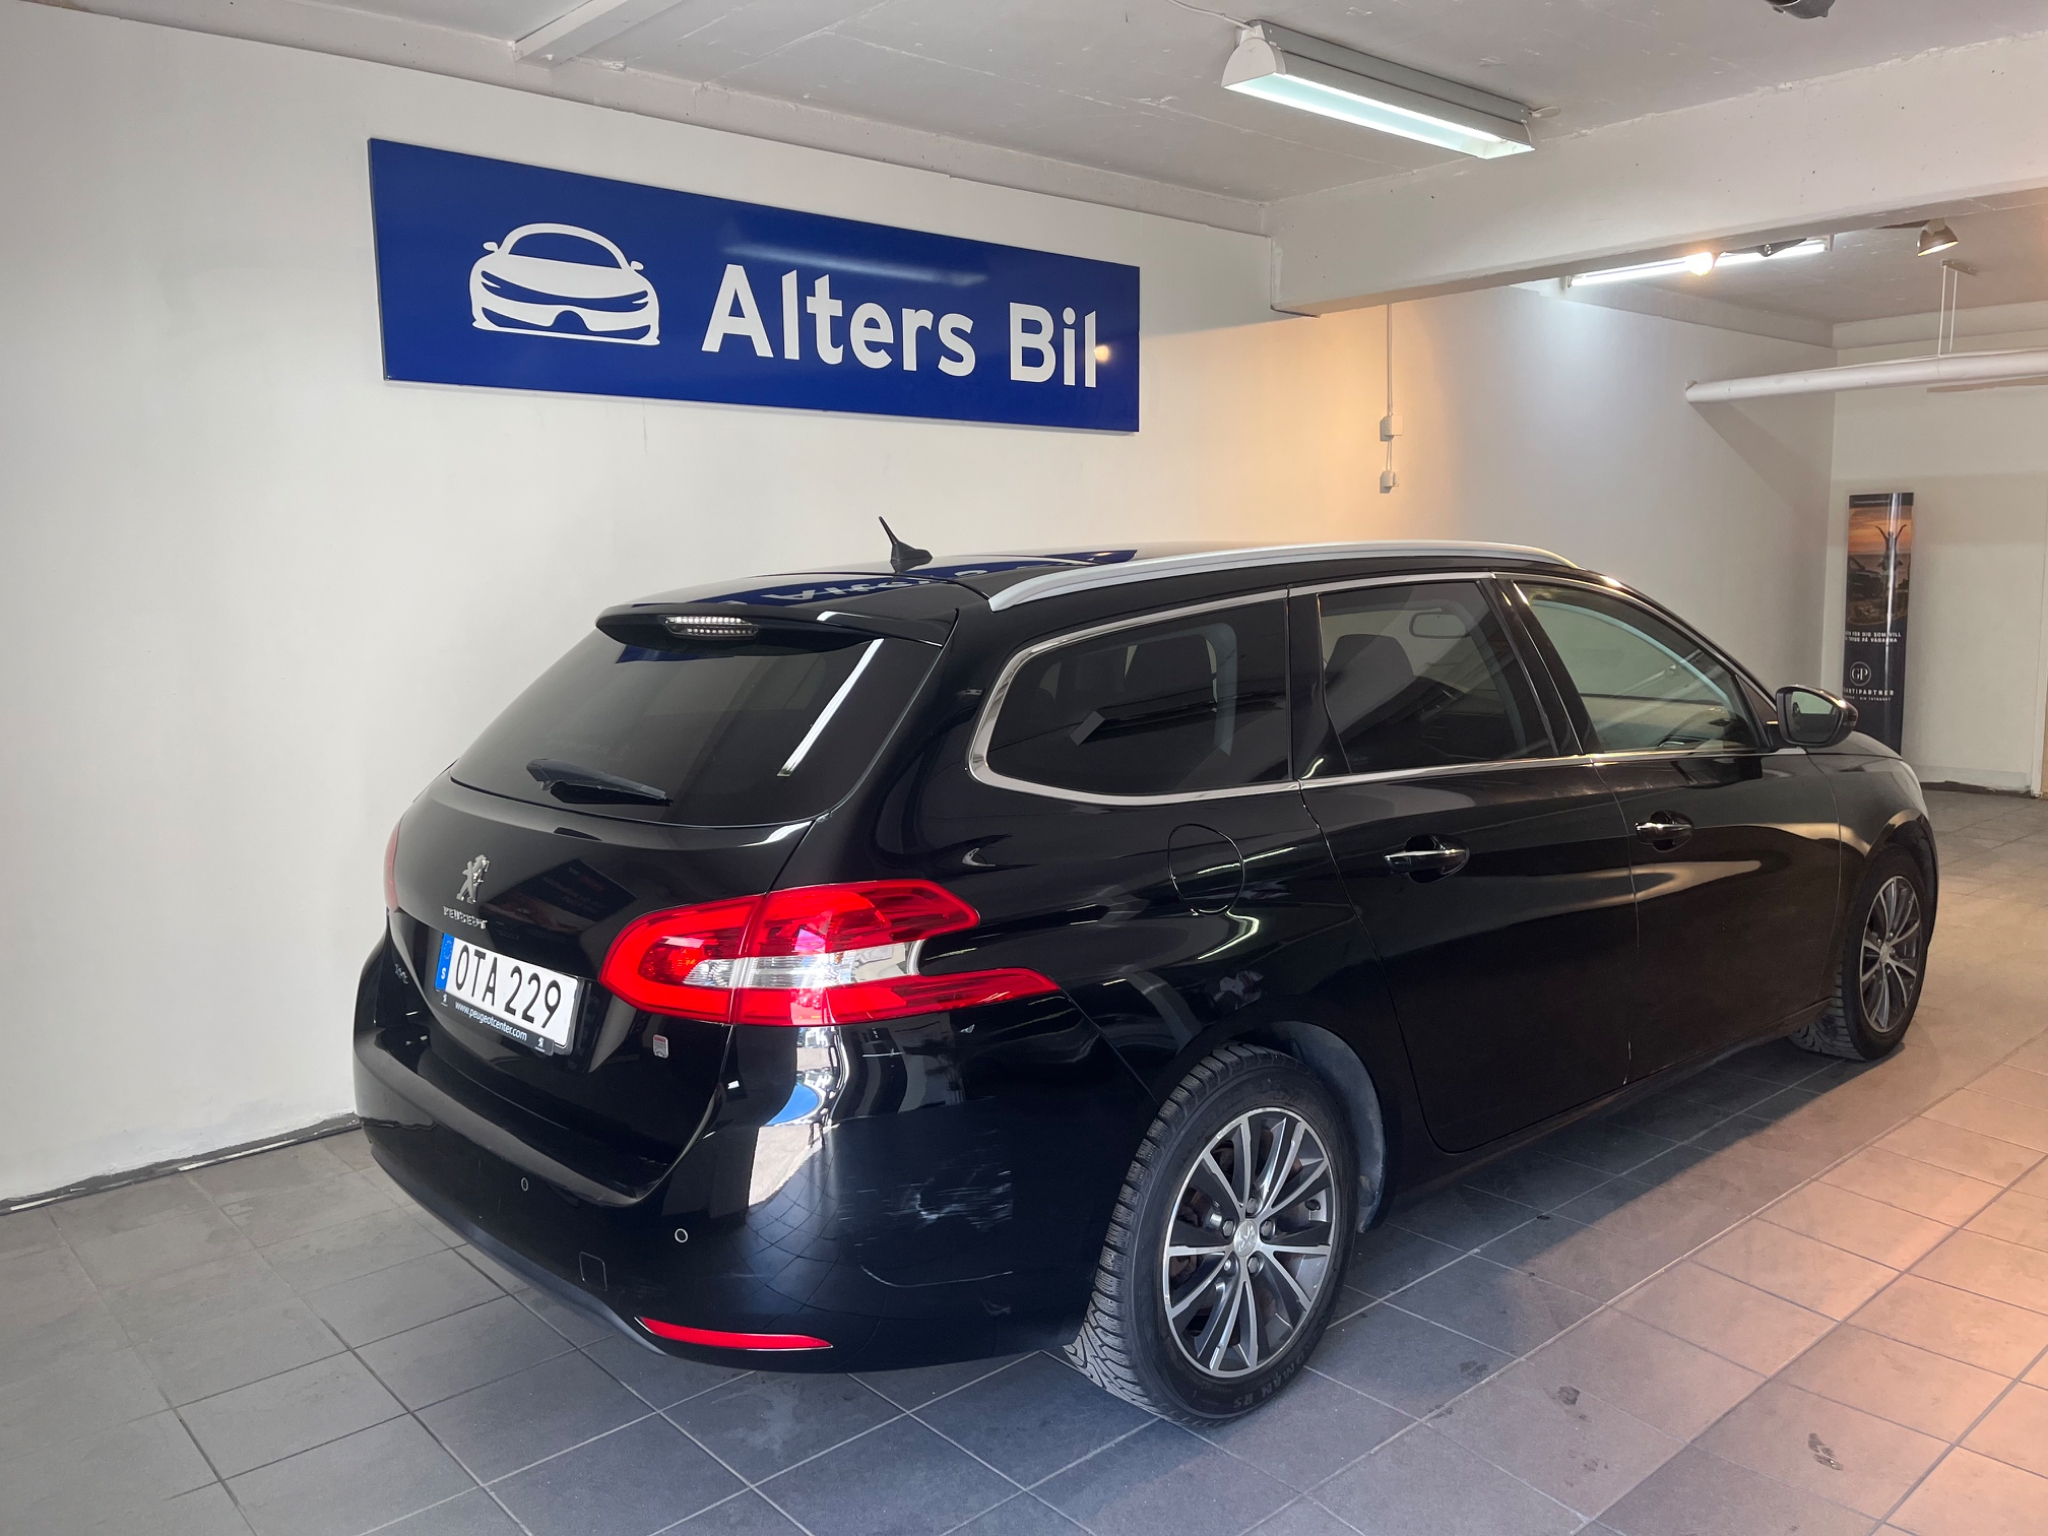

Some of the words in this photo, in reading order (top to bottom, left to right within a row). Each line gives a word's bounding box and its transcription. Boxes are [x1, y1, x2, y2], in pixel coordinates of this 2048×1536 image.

[702, 263, 976, 377] Alters
[1009, 301, 1097, 388] Bil
[1851, 667, 1868, 681] GP
[443, 905, 488, 930] PEUGEOT
[440, 967, 447, 980] S
[455, 944, 498, 1007] OTA
[504, 965, 562, 1029] 229
[454, 1001, 528, 1042] www.peugeotcenter.com
